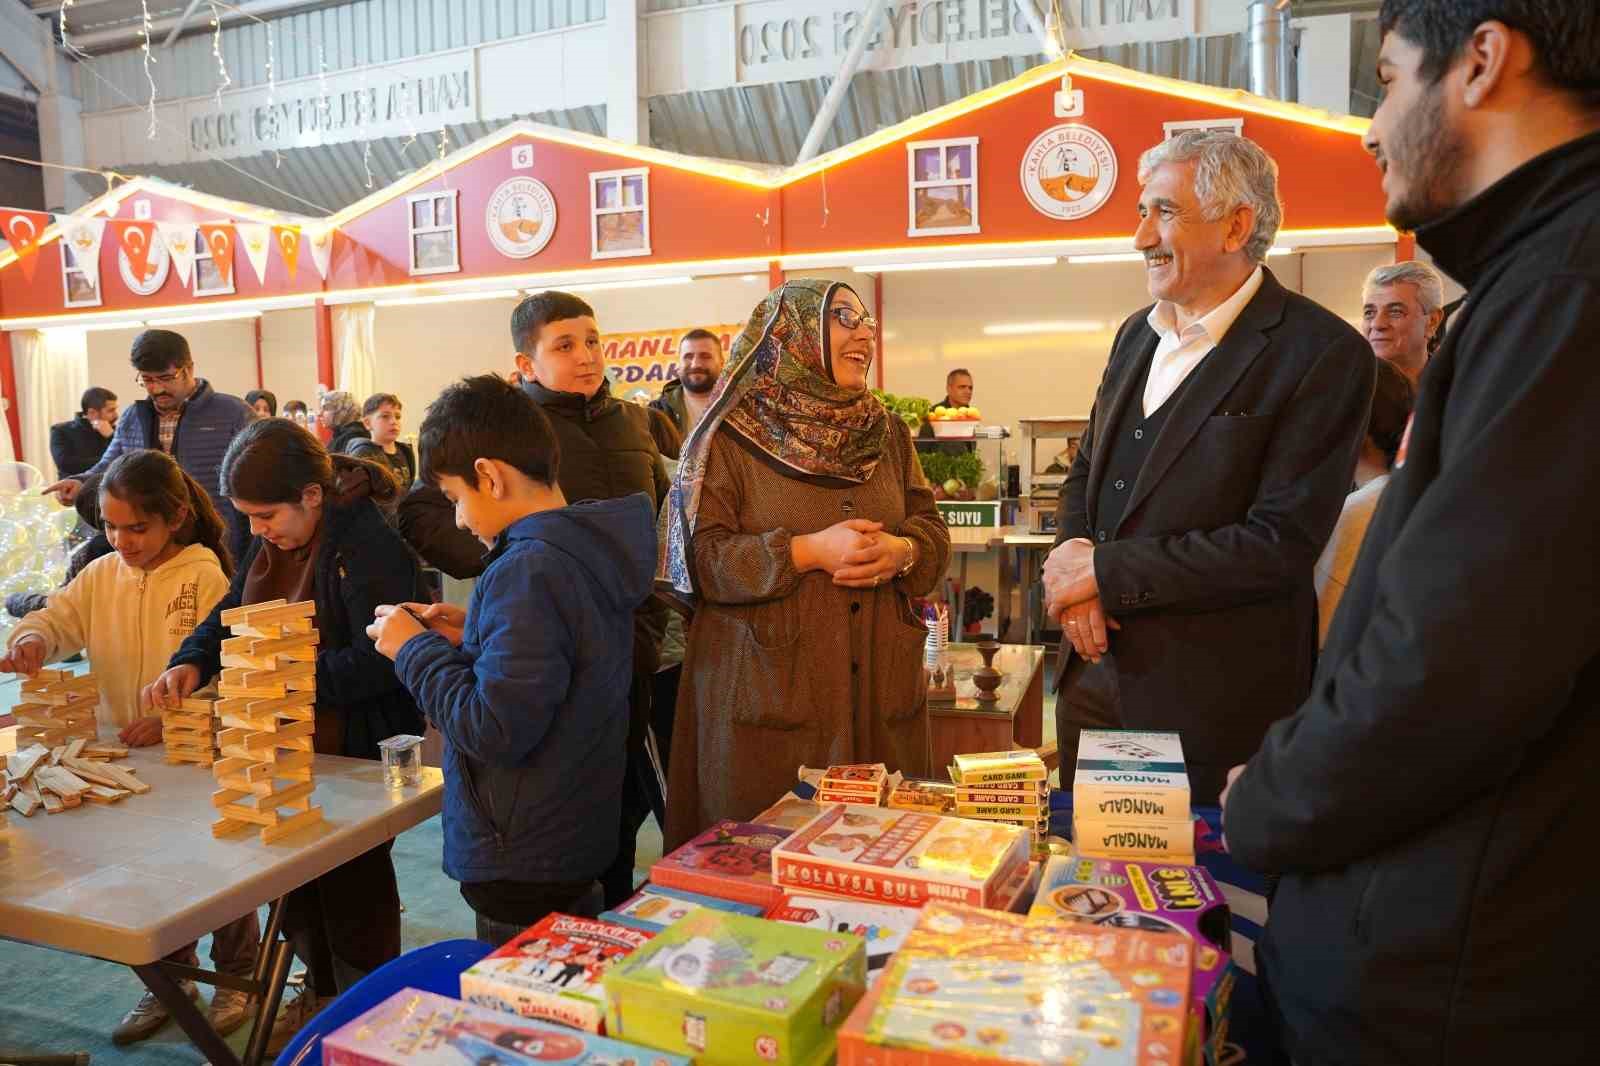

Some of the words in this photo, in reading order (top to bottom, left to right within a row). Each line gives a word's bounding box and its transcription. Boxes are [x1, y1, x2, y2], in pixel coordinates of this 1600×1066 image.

[517, 150, 528, 165] 6
[947, 511, 982, 525] SUYU
[982, 774, 1003, 782] CARD
[1006, 771, 1027, 780] GAME
[1095, 774, 1170, 784] MANGALA
[998, 795, 1019, 803] CARD
[999, 807, 1021, 815] CARD
[1098, 798, 1164, 815] MANGALA
[1103, 832, 1168, 850] MANGALA
[786, 864, 875, 894] KOLAYSA
[883, 880, 919, 900] BUL
[926, 883, 969, 899] WHAT
